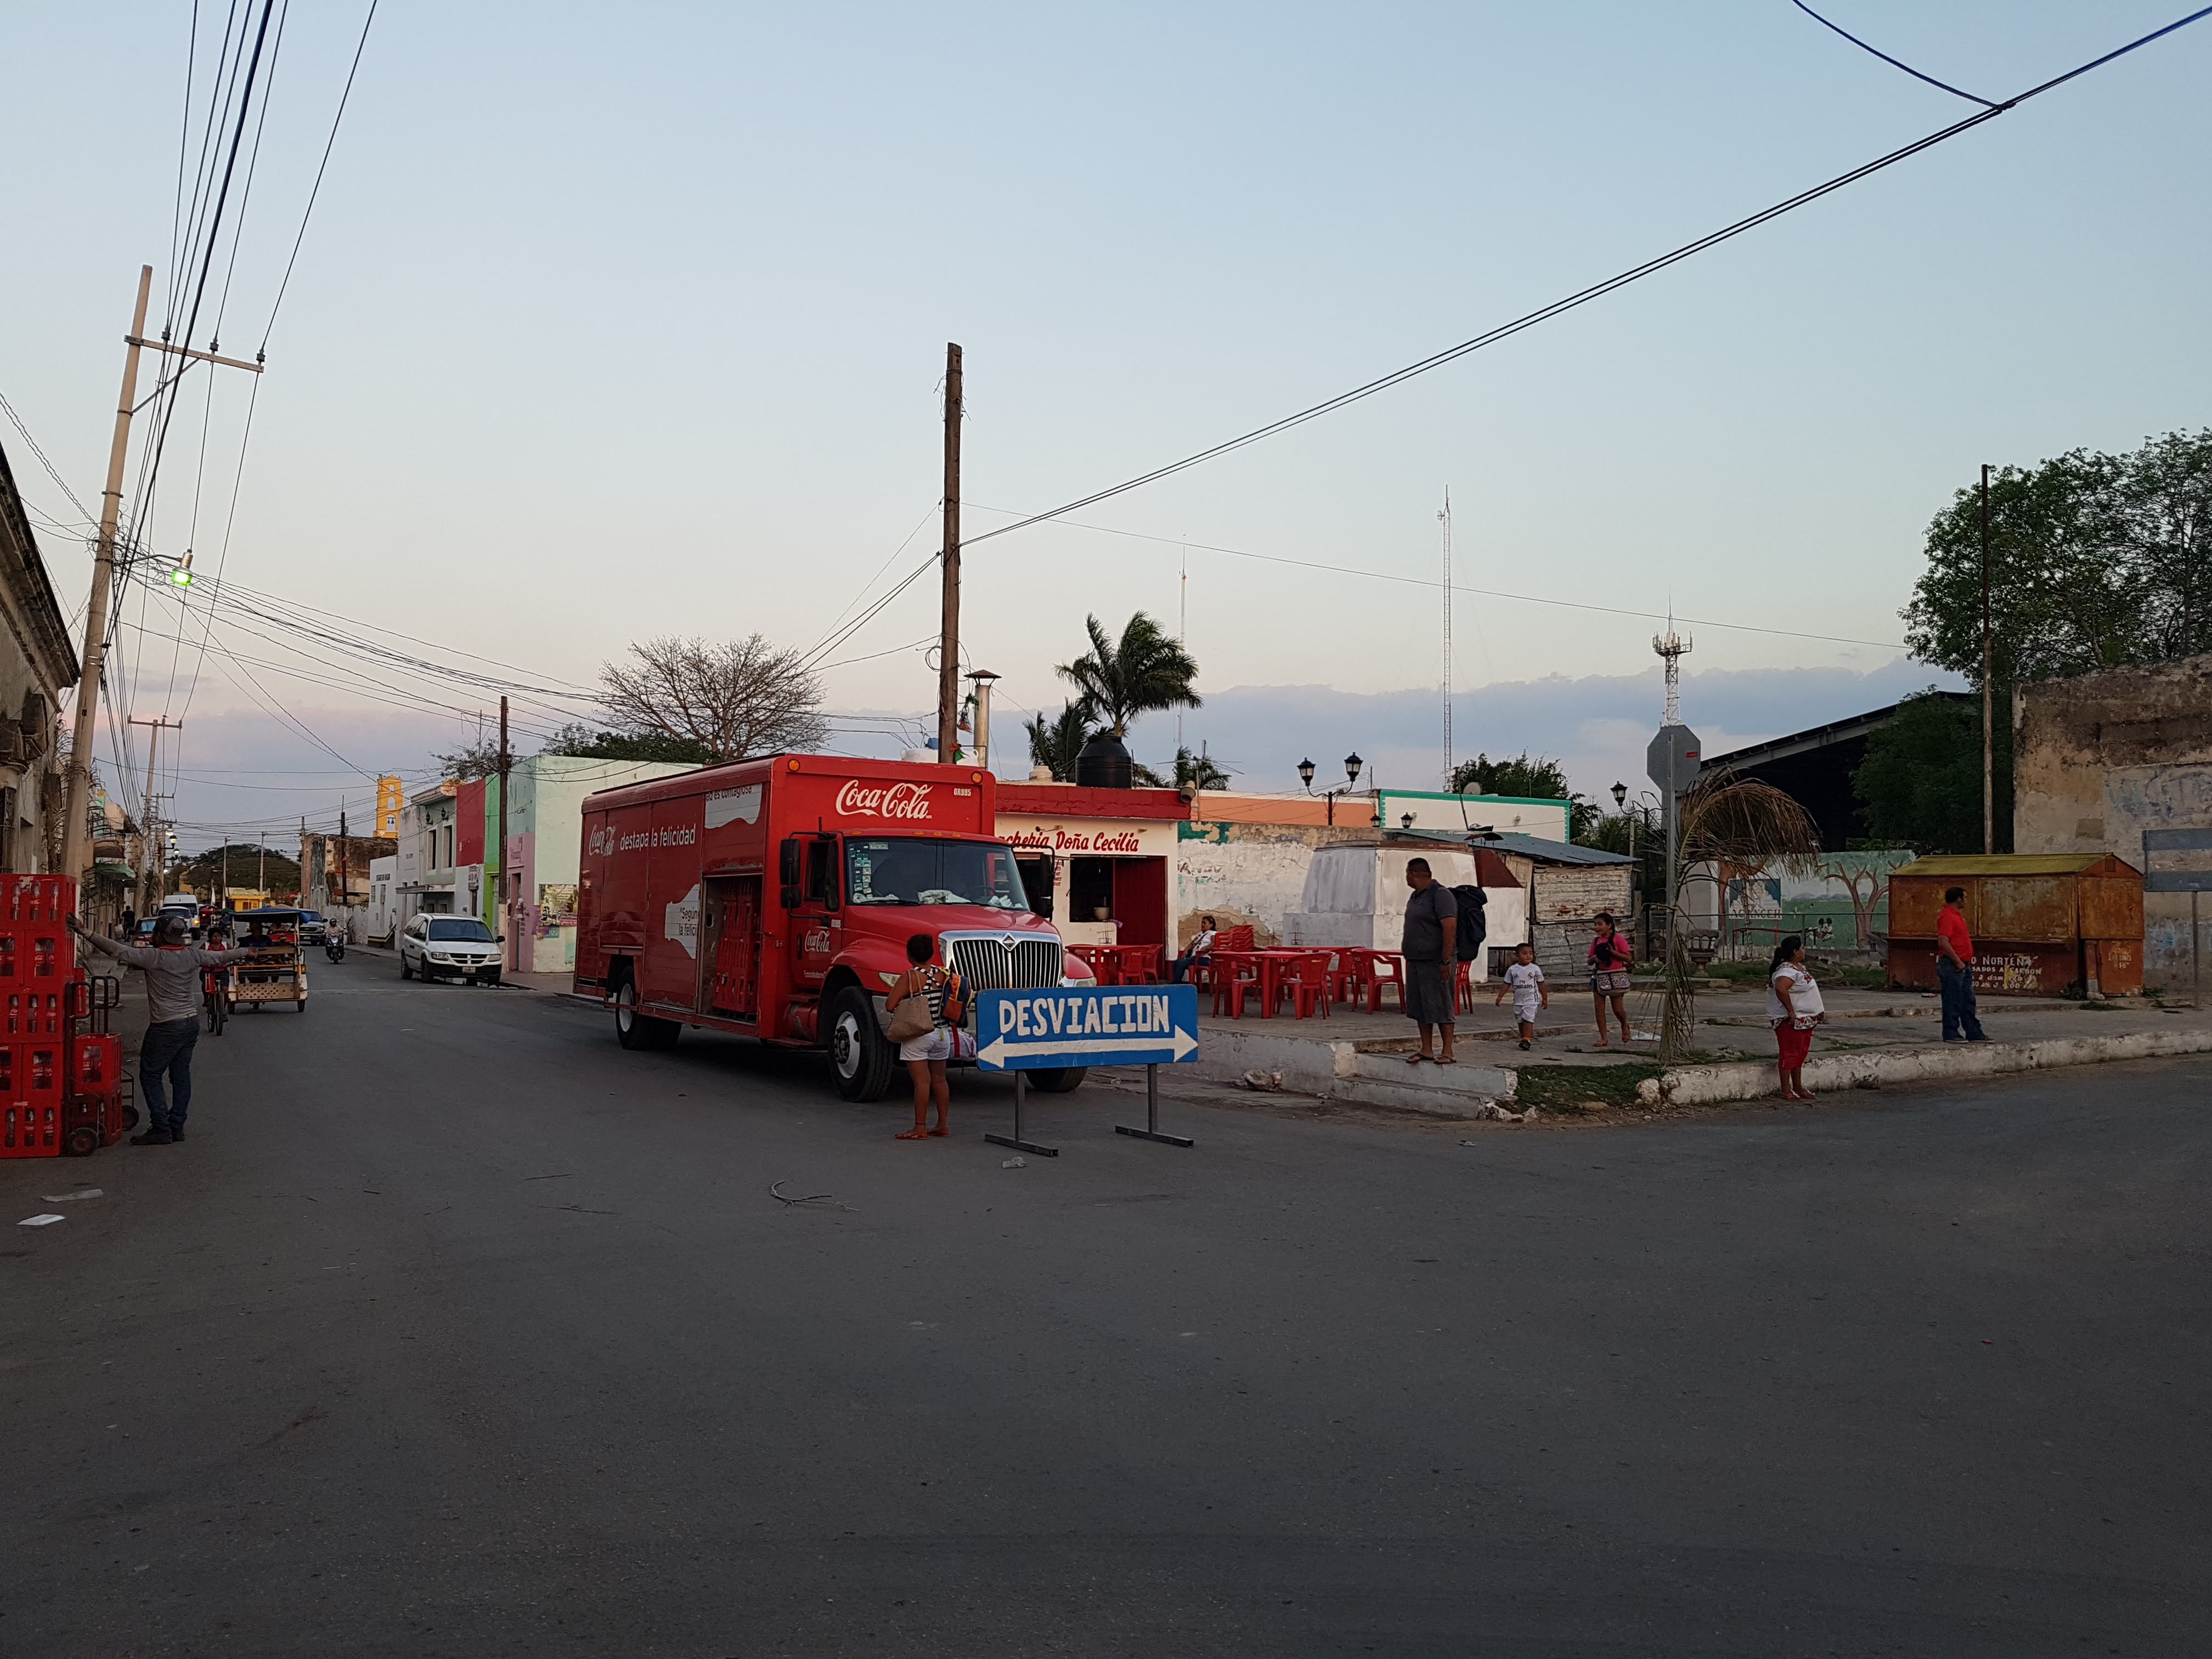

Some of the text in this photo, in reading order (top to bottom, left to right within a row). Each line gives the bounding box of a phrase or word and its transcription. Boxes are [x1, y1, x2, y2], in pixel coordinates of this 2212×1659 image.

[836, 780, 933, 819] Coca-Cola
[620, 832, 648, 851] destapa
[651, 827, 659, 847] la
[660, 823, 696, 847] felicidad
[1056, 831, 1090, 850] Doña
[1093, 832, 1139, 852] Cecilia
[999, 995, 1170, 1036] DESVIACION
